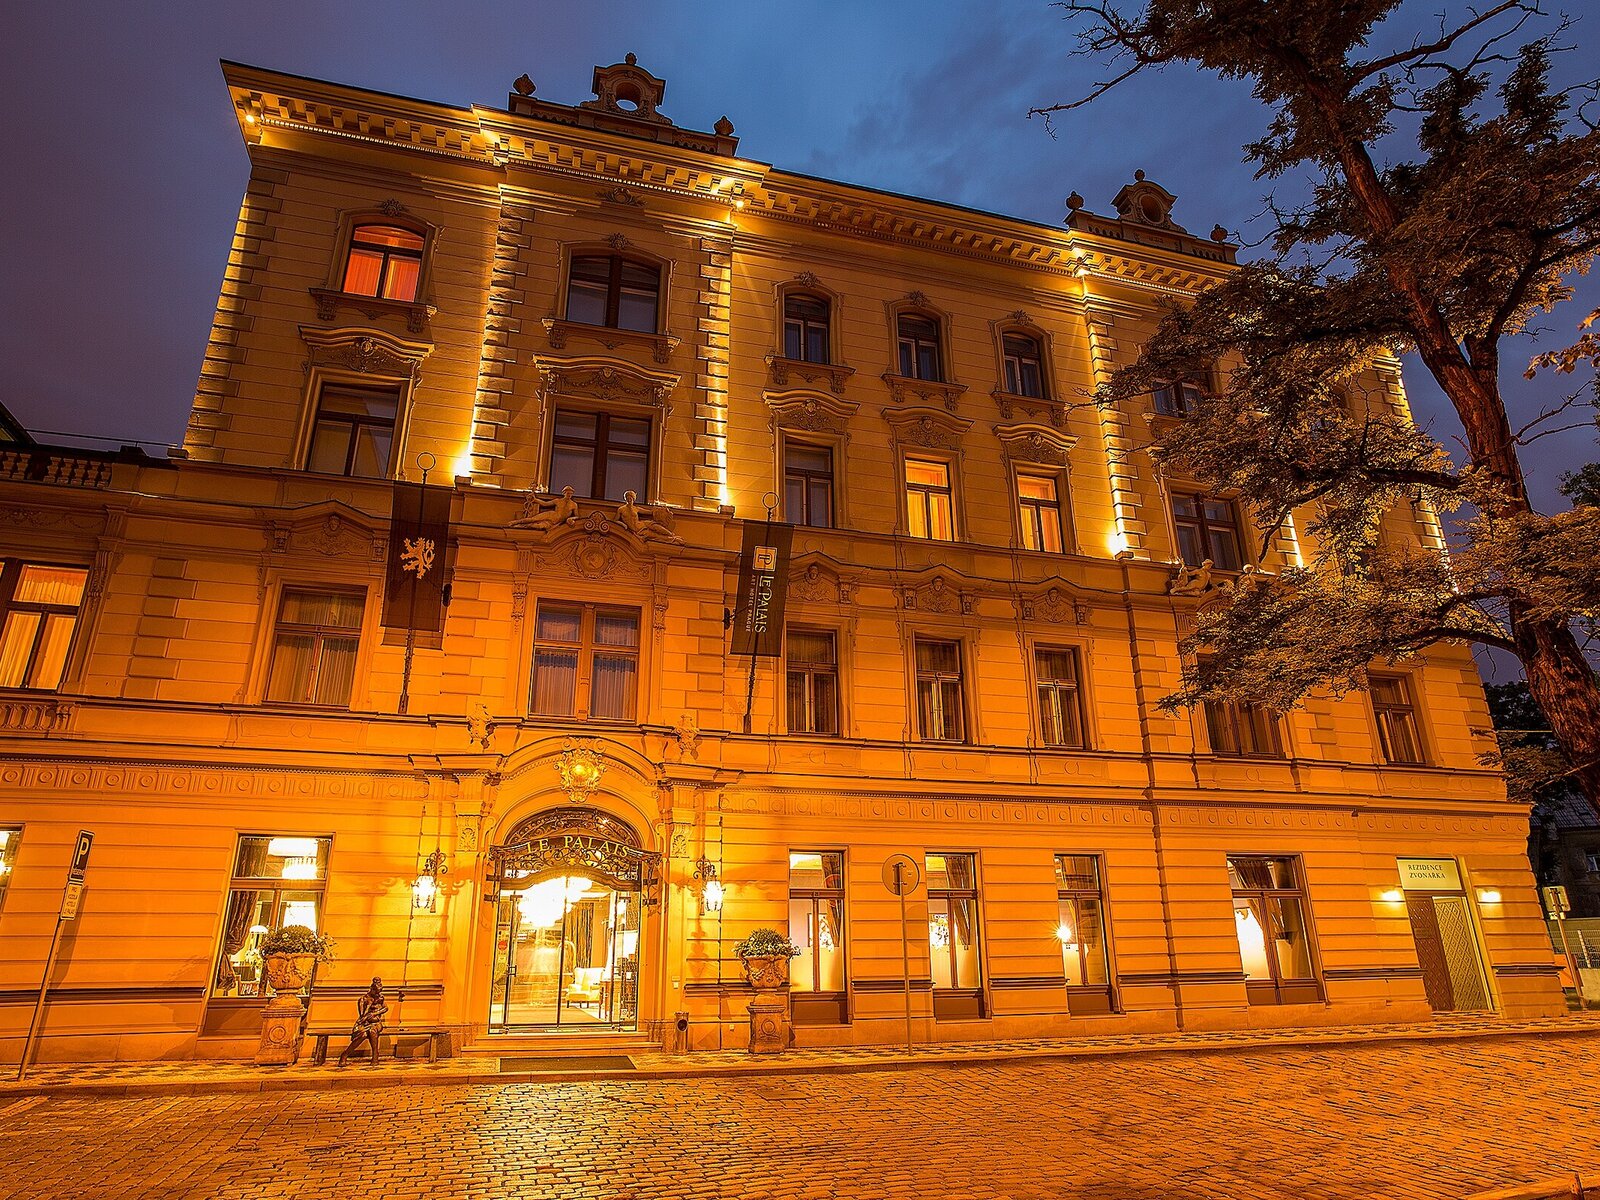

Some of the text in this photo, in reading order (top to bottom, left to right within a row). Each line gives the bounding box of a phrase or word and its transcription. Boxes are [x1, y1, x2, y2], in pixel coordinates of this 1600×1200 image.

[754, 575, 774, 633] LE PALAIS
[745, 609, 753, 632] PRAGUE
[75, 837, 90, 865] P
[526, 835, 629, 858] LE PALAIS
